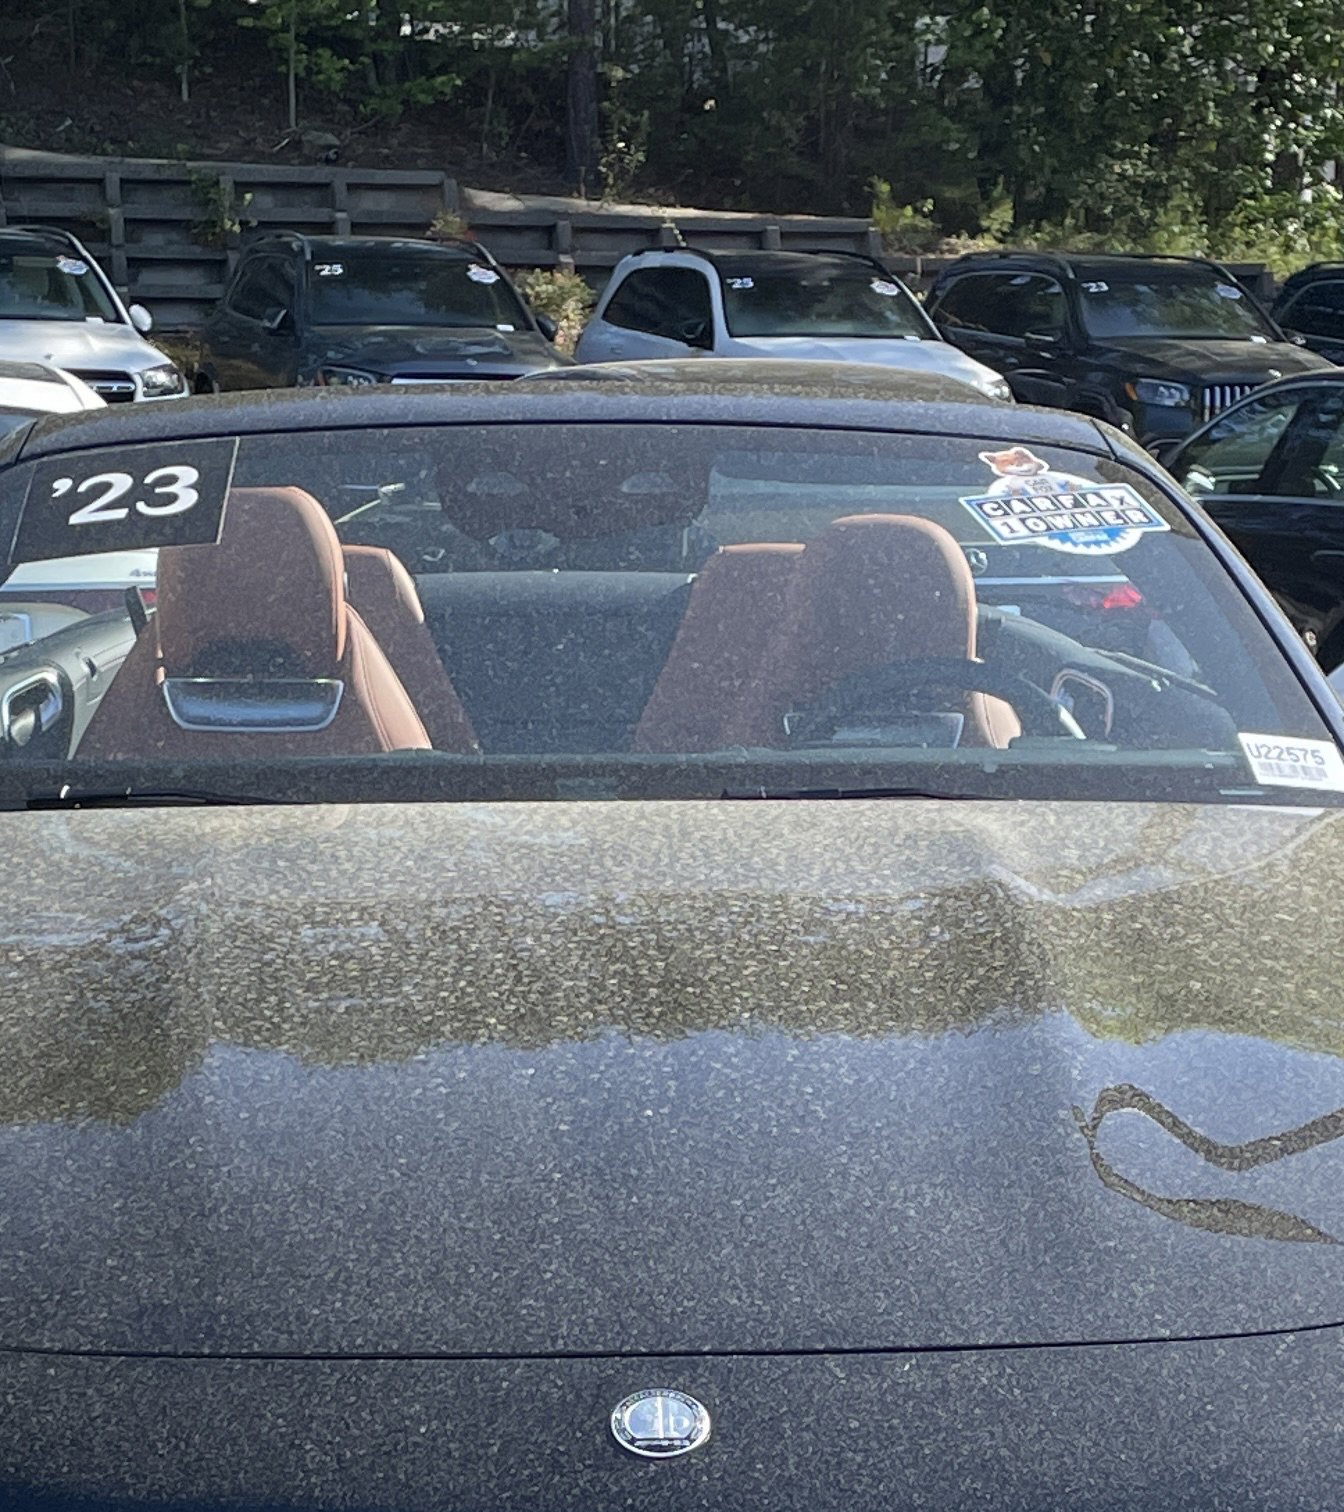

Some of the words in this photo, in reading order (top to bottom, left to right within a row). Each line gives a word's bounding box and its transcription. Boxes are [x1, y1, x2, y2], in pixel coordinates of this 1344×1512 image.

[50, 464, 200, 526] '23
[978, 491, 1140, 518] CARFAX
[998, 517, 1022, 534] 1
[1023, 508, 1152, 534] OWNER
[1245, 742, 1327, 766] U22575
